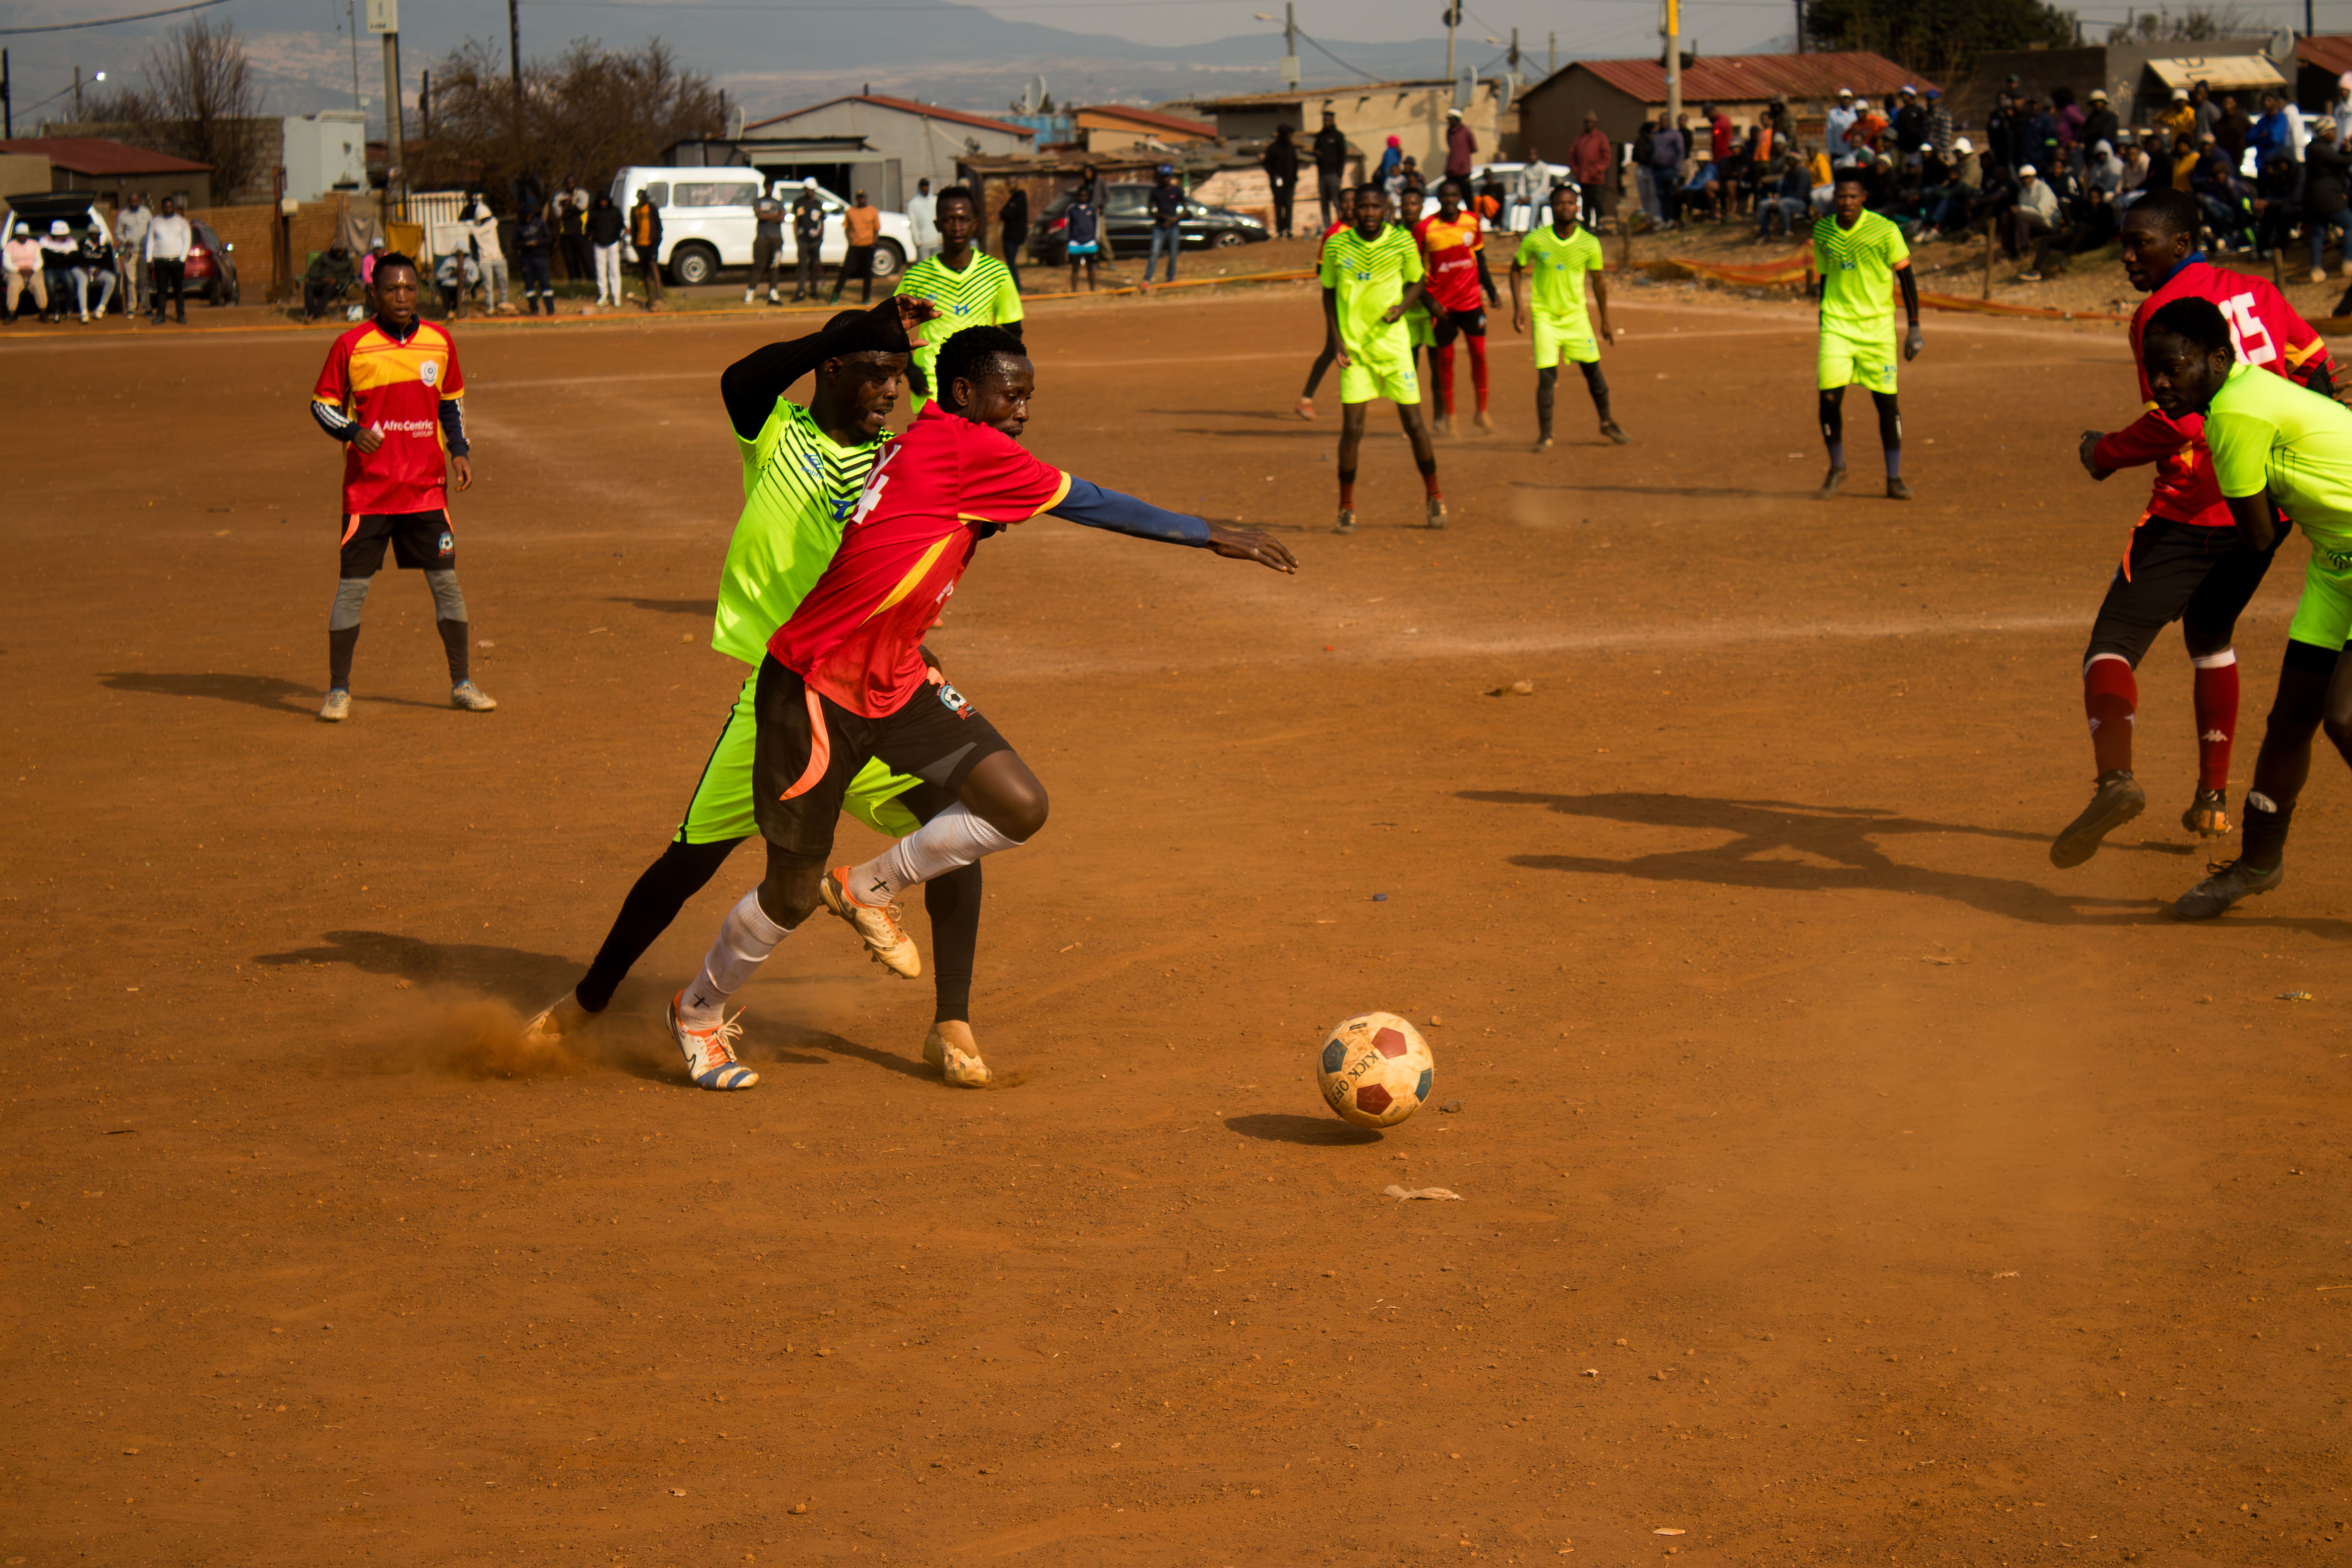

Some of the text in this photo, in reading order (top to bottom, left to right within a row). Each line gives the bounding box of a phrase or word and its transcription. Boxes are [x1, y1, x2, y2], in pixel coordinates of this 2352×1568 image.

[383, 419, 434, 432] AfroCentric
[1347, 1051, 1379, 1081] KICK
[1331, 1080, 1349, 1104] OFF
